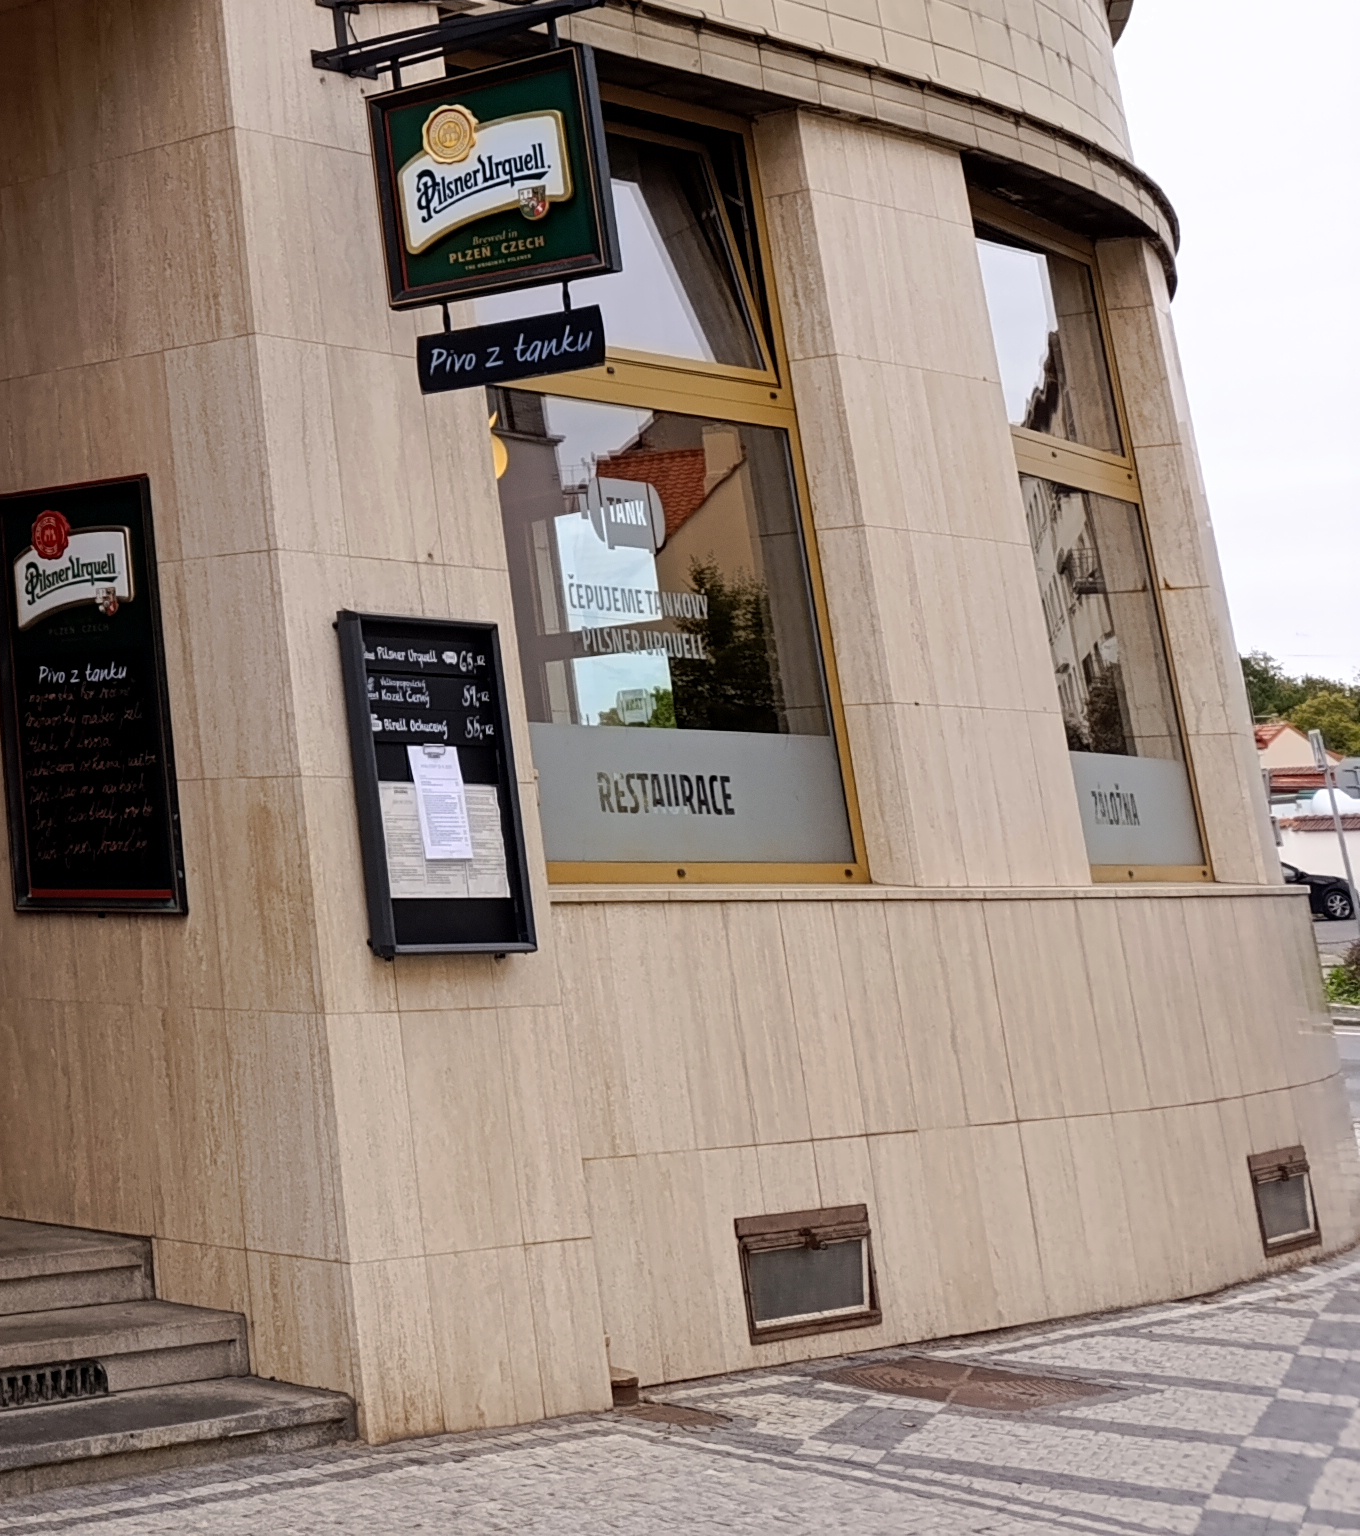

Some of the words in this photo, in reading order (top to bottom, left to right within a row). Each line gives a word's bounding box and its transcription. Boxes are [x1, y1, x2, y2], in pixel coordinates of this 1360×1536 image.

[416, 169, 480, 223] Pilsner
[448, 244, 492, 264] PLZEŇ
[501, 235, 545, 254] CZECH
[472, 230, 506, 245] Brewed
[508, 228, 518, 238] in
[430, 348, 476, 376] Pivo
[485, 346, 504, 368] z
[514, 324, 593, 363] tanku
[606, 497, 647, 526] TANK
[25, 562, 71, 605] Pilsner
[69, 553, 116, 586] Urquell
[568, 574, 644, 614] ČEPUJEME
[645, 588, 708, 620] TANKOVÝ
[377, 646, 405, 661] Pilsner
[407, 649, 437, 668] Urquell
[582, 626, 641, 654] PILSNER
[643, 630, 707, 659] URQUELL
[39, 666, 66, 685] Pivo
[70, 670, 81, 683] z
[85, 661, 128, 682] tanku
[381, 689, 404, 702] Kozel
[406, 688, 430, 708] Černý
[384, 718, 408, 731] Birell
[410, 719, 448, 740] Ochucený
[597, 771, 735, 815] RESTAURACE
